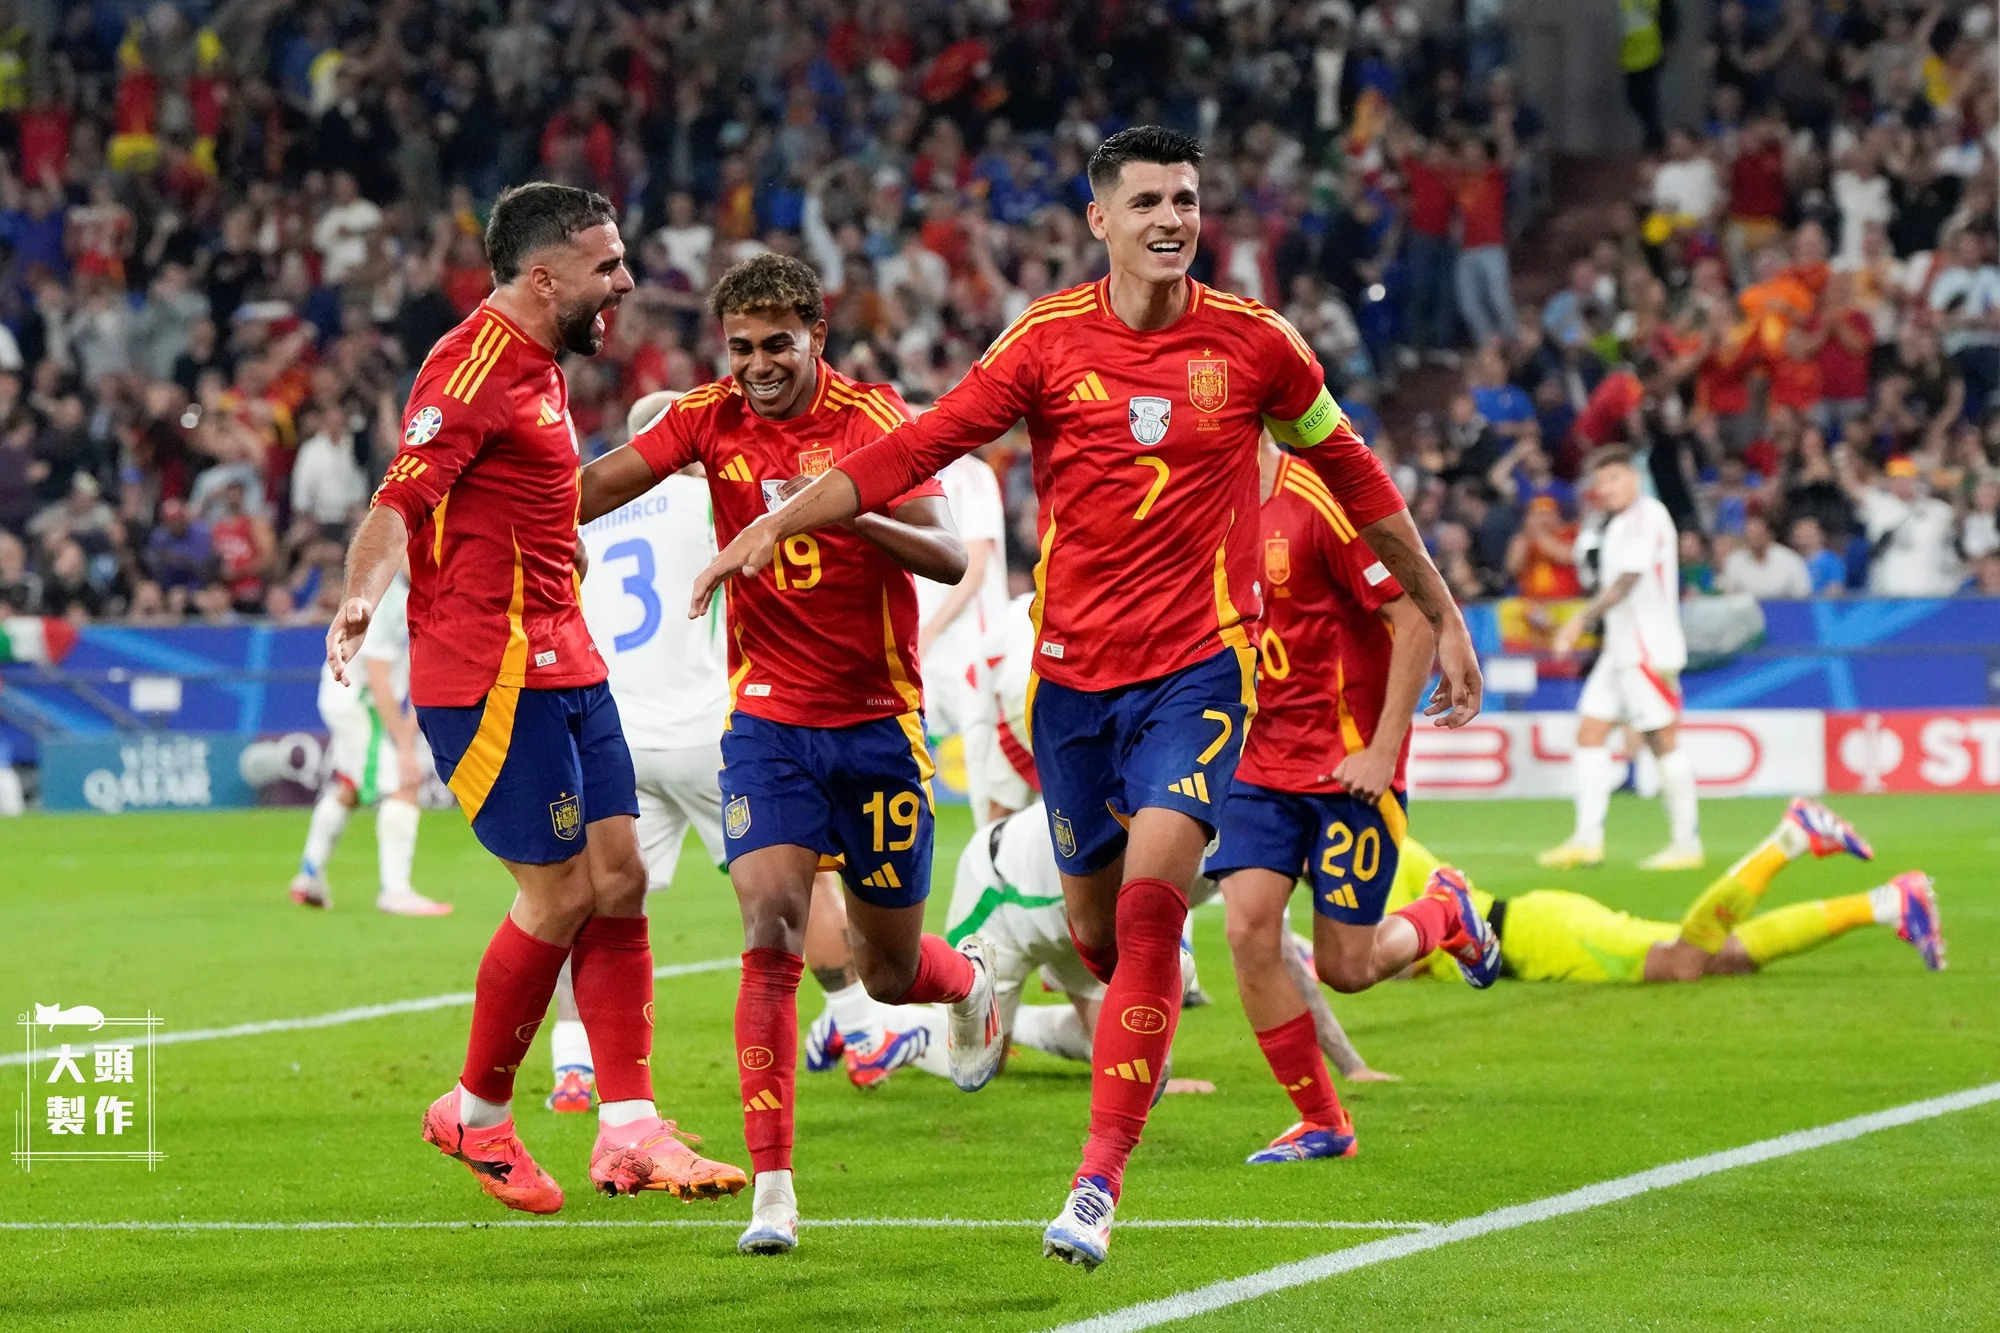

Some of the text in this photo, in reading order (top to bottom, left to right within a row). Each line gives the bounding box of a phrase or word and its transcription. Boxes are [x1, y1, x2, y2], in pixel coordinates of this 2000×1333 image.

[1303, 395, 1332, 430] RESPEC
[1132, 456, 1170, 520] 7
[773, 534, 822, 590] 19
[602, 538, 661, 653] 3
[1257, 628, 1290, 680] 0
[1196, 709, 1232, 766] 7
[863, 791, 920, 852] 19
[1321, 821, 1380, 882] 20
